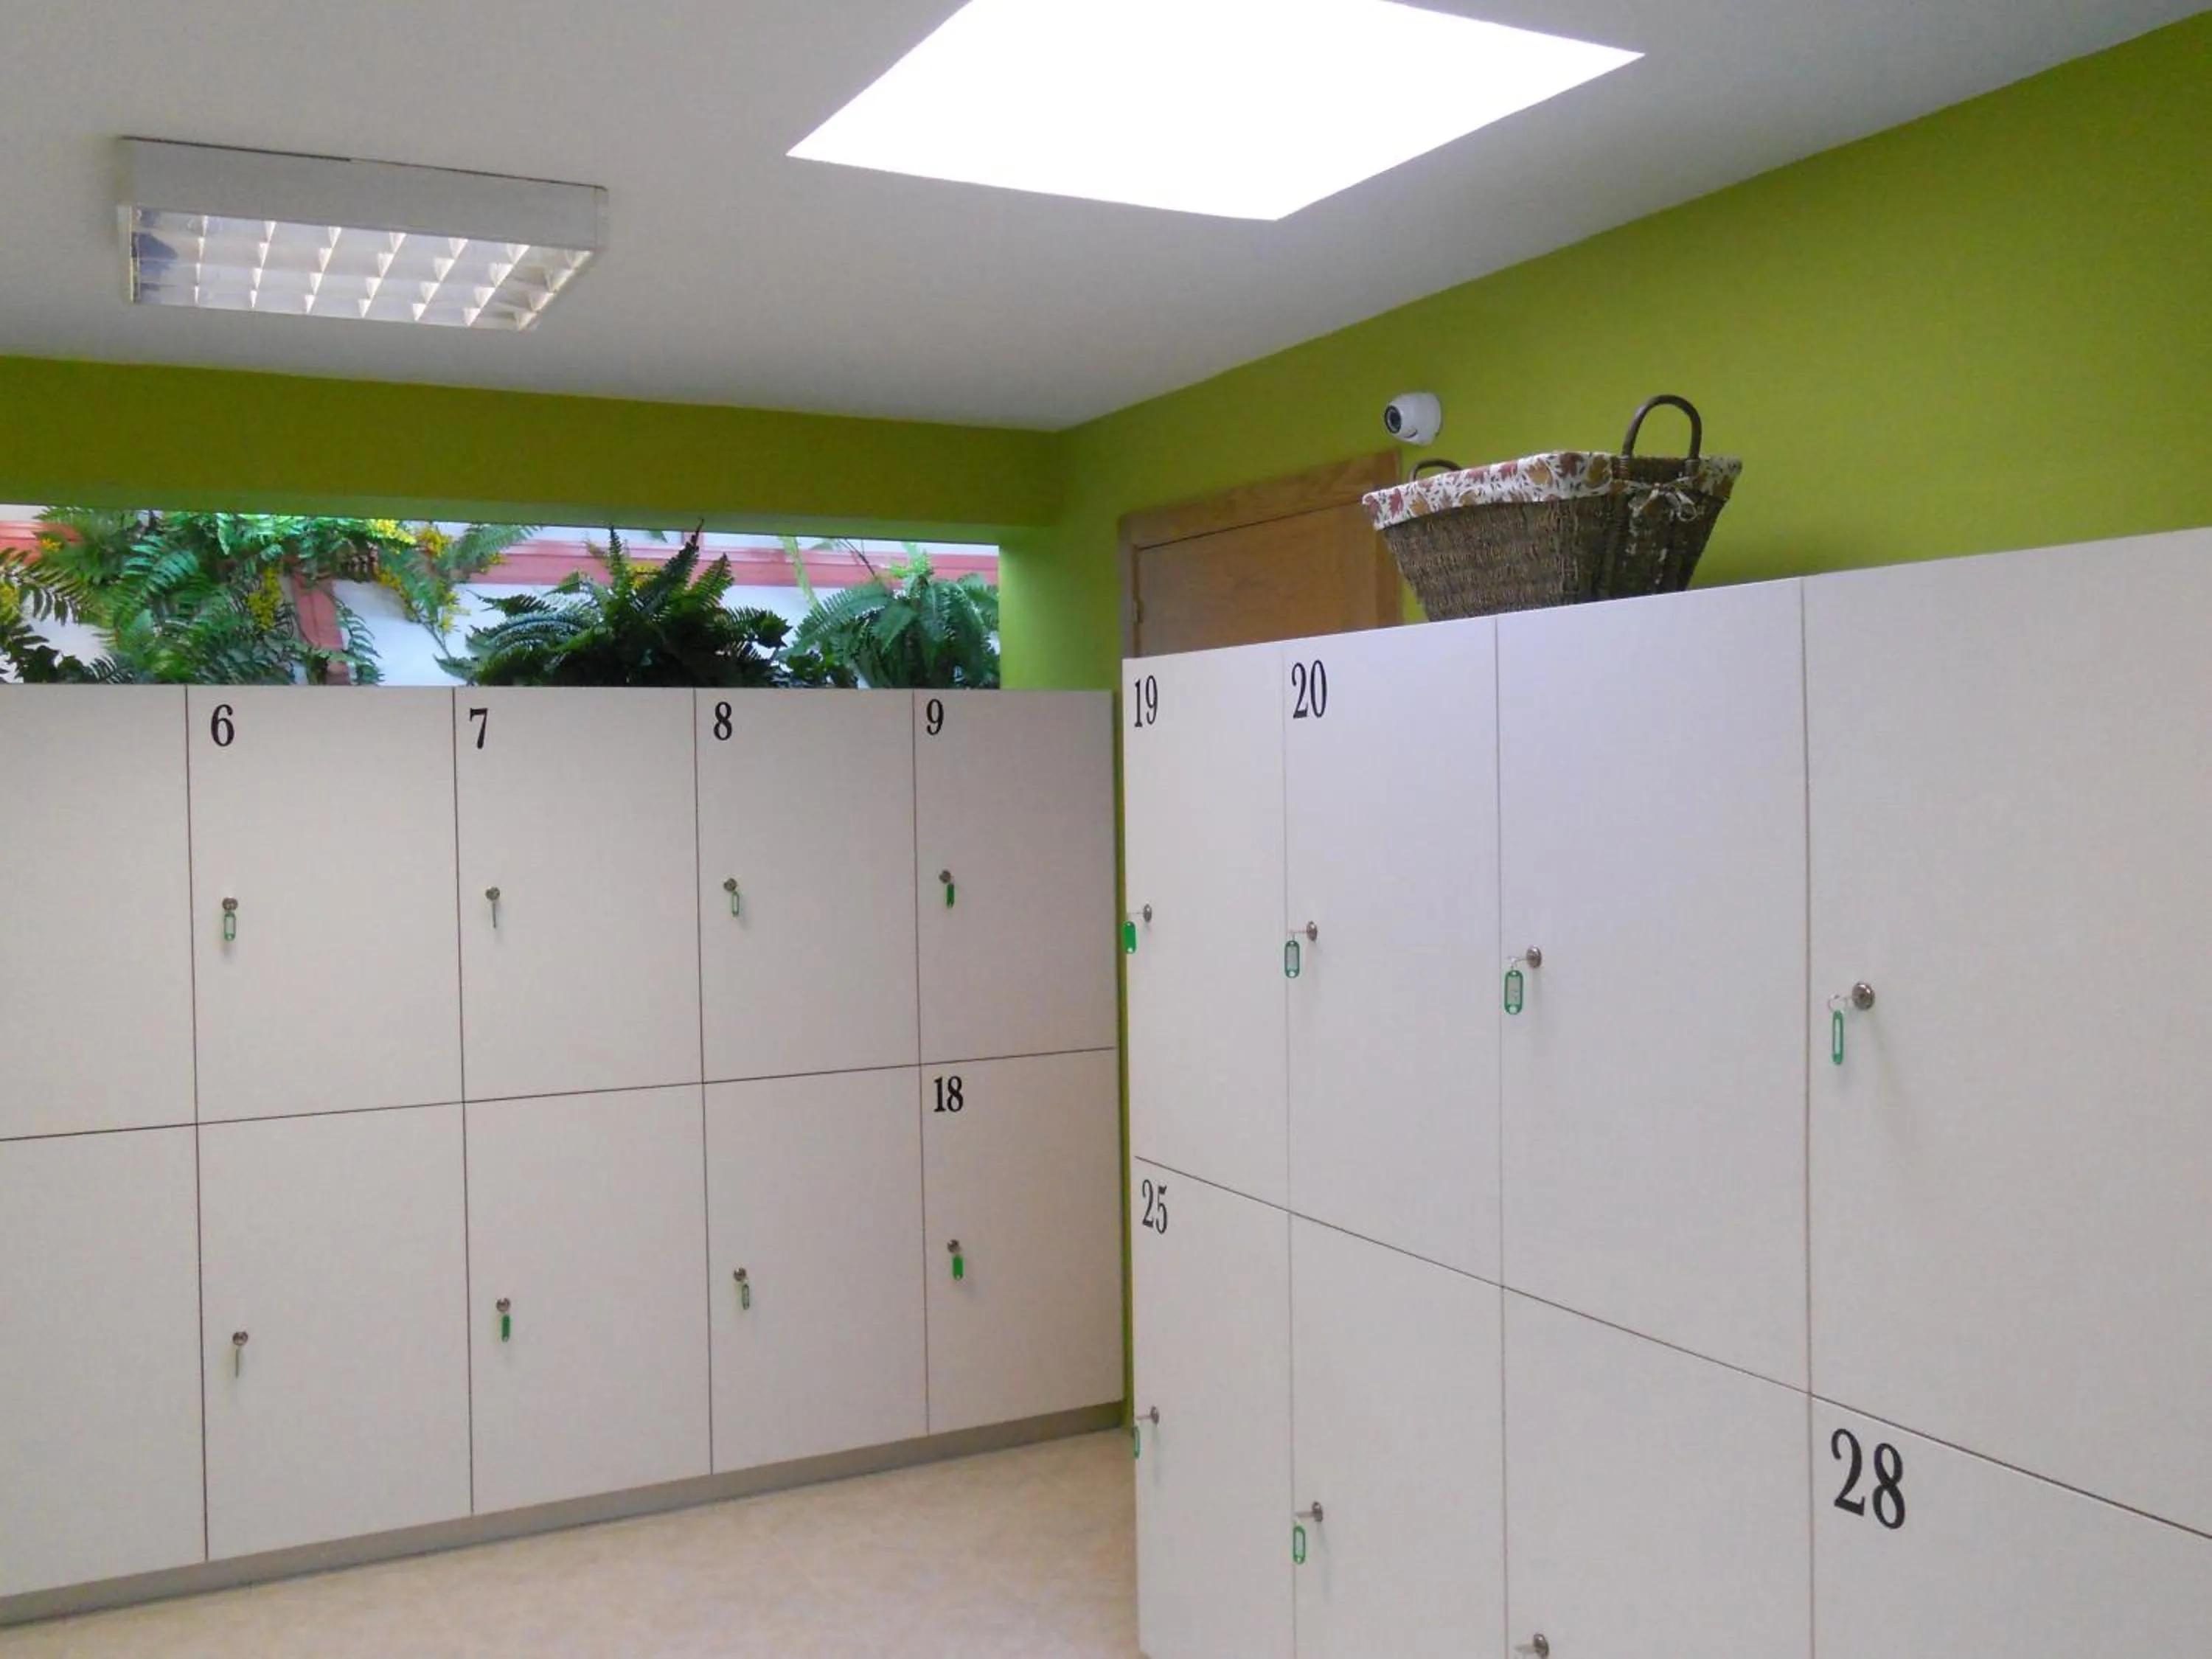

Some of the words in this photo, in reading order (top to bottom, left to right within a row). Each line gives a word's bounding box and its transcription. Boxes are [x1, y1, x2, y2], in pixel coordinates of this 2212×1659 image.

[1134, 675, 1158, 728] 19
[1291, 659, 1328, 719] 20
[210, 703, 235, 748] 6
[468, 708, 488, 749] 7
[713, 701, 733, 741] 8
[926, 698, 945, 736] 9
[933, 1076, 964, 1113] 18
[1141, 1179, 1168, 1234] 25
[1831, 1428, 1906, 1529] 28
